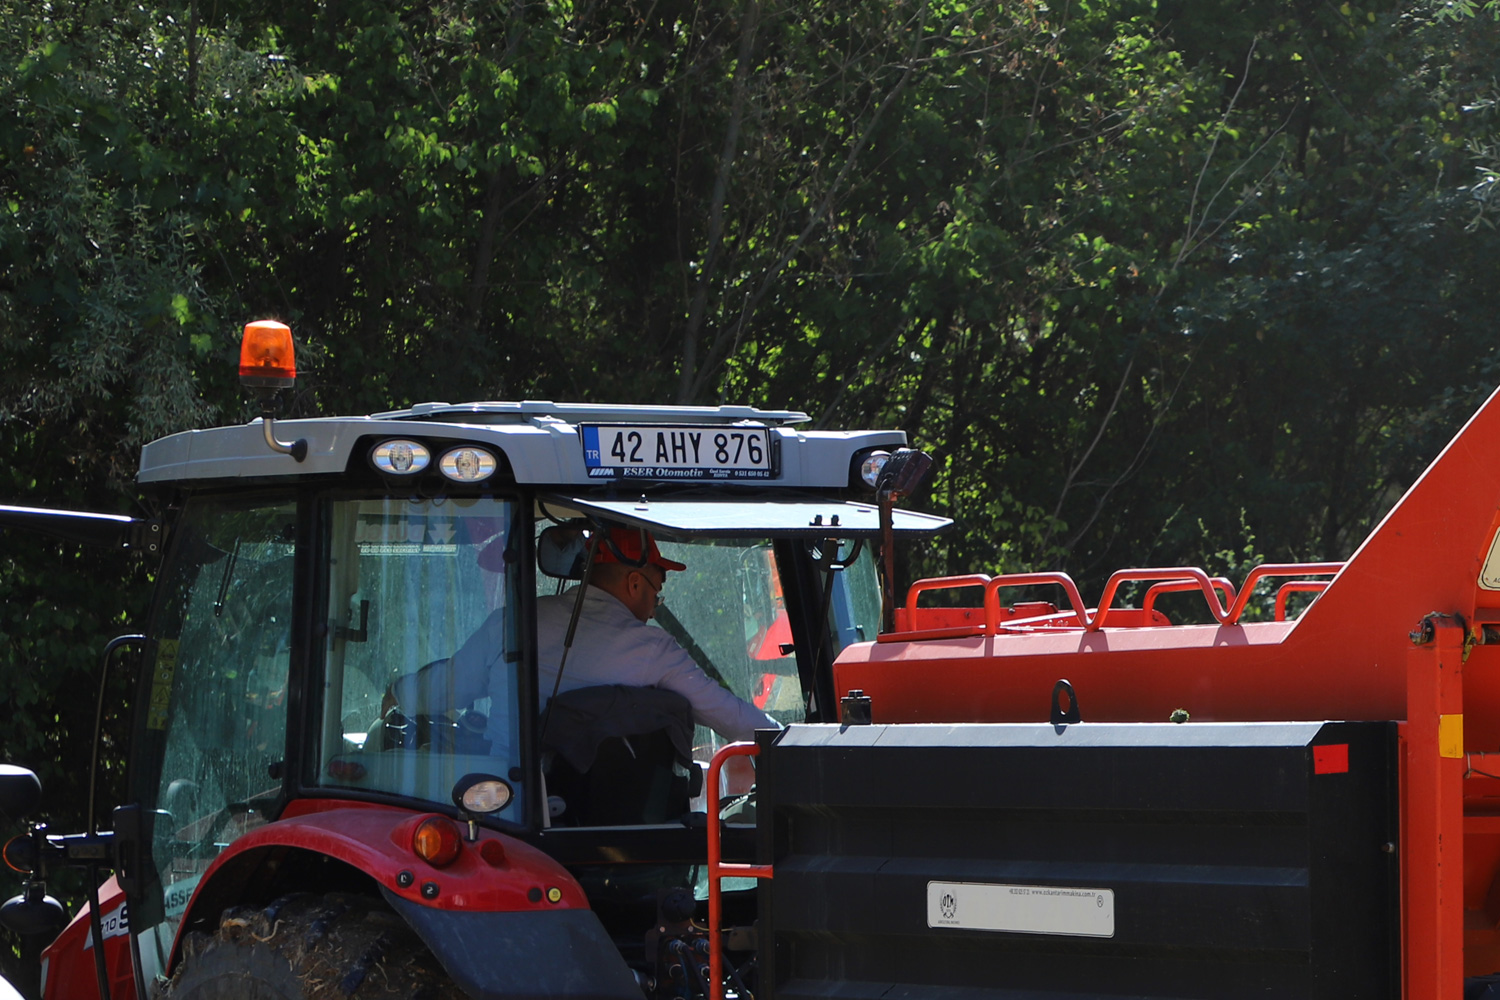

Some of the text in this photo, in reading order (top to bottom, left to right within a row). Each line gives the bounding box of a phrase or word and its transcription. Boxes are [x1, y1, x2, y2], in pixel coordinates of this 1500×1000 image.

[611, 431, 763, 465] 42 AHY 876
[587, 450, 599, 459] TR
[623, 467, 704, 477] ESER Otomotiv
